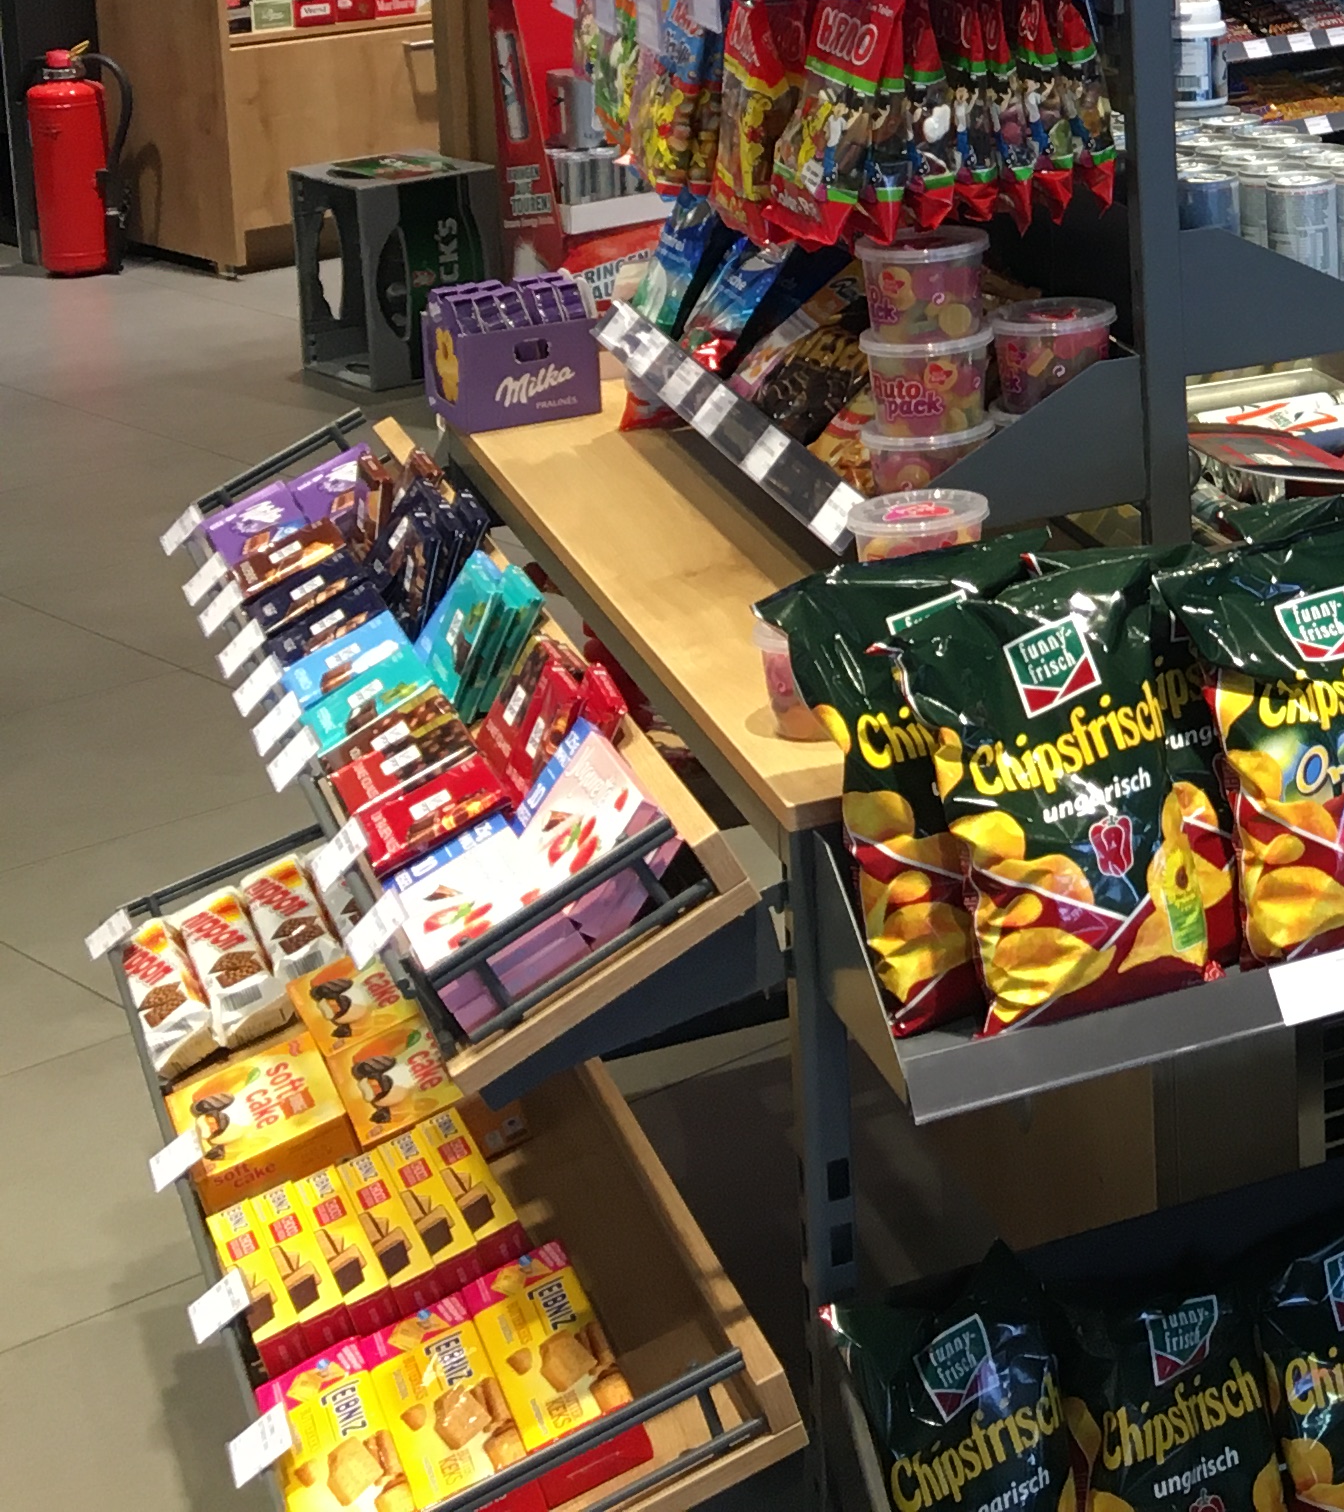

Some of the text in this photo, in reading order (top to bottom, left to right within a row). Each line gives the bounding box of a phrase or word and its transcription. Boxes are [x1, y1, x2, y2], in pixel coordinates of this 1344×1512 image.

[438, 215, 459, 282] CK'S
[494, 362, 576, 408] Milka
[887, 393, 945, 421] pack
[1292, 600, 1342, 624] funny-
[1018, 626, 1072, 660] funny-
[1026, 652, 1077, 685] frisch
[970, 680, 1164, 796] Chipsfrisch
[1042, 768, 1153, 825] ungarisch
[266, 1061, 306, 1100] soft
[407, 1050, 443, 1092] cake
[245, 1088, 280, 1130] cake
[213, 1161, 278, 1190] soft cake
[527, 1275, 577, 1330] LEIBNIZ
[425, 1330, 474, 1386] LEIBNIZ
[928, 1331, 977, 1366] funny-
[937, 1351, 978, 1390] frisch
[320, 1379, 368, 1437] LEIBNIZ
[1102, 1359, 1263, 1472] Chipsfrisch
[889, 1372, 1064, 1512] Chipsfrisch
[1152, 1446, 1241, 1500] ungarisch
